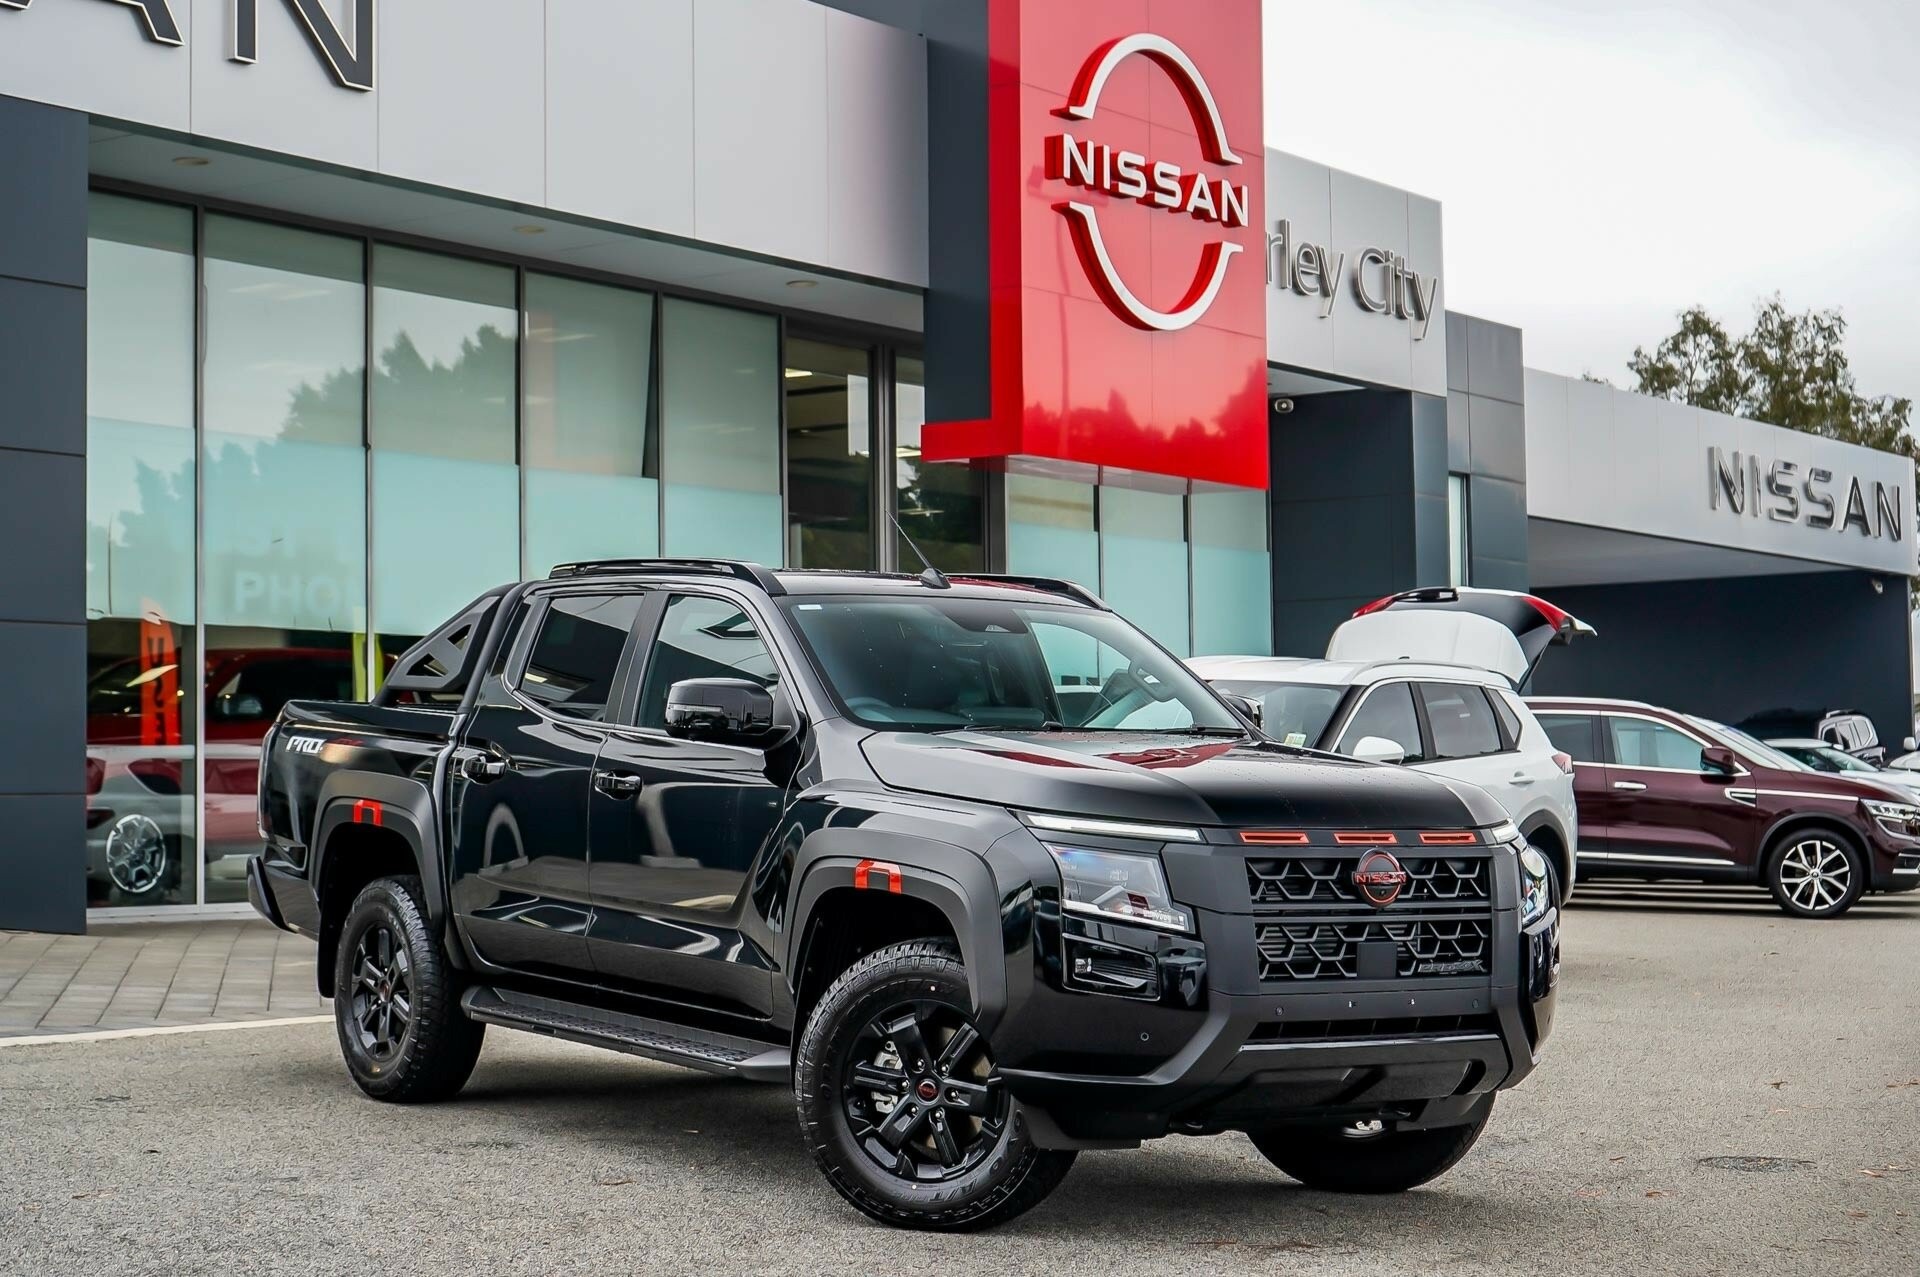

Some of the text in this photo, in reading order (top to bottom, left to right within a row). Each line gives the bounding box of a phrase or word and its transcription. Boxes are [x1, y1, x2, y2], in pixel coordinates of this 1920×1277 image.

[1062, 132, 1249, 228] NISSAN
[1356, 247, 1438, 341] City
[1709, 446, 1902, 542] NISSAN
